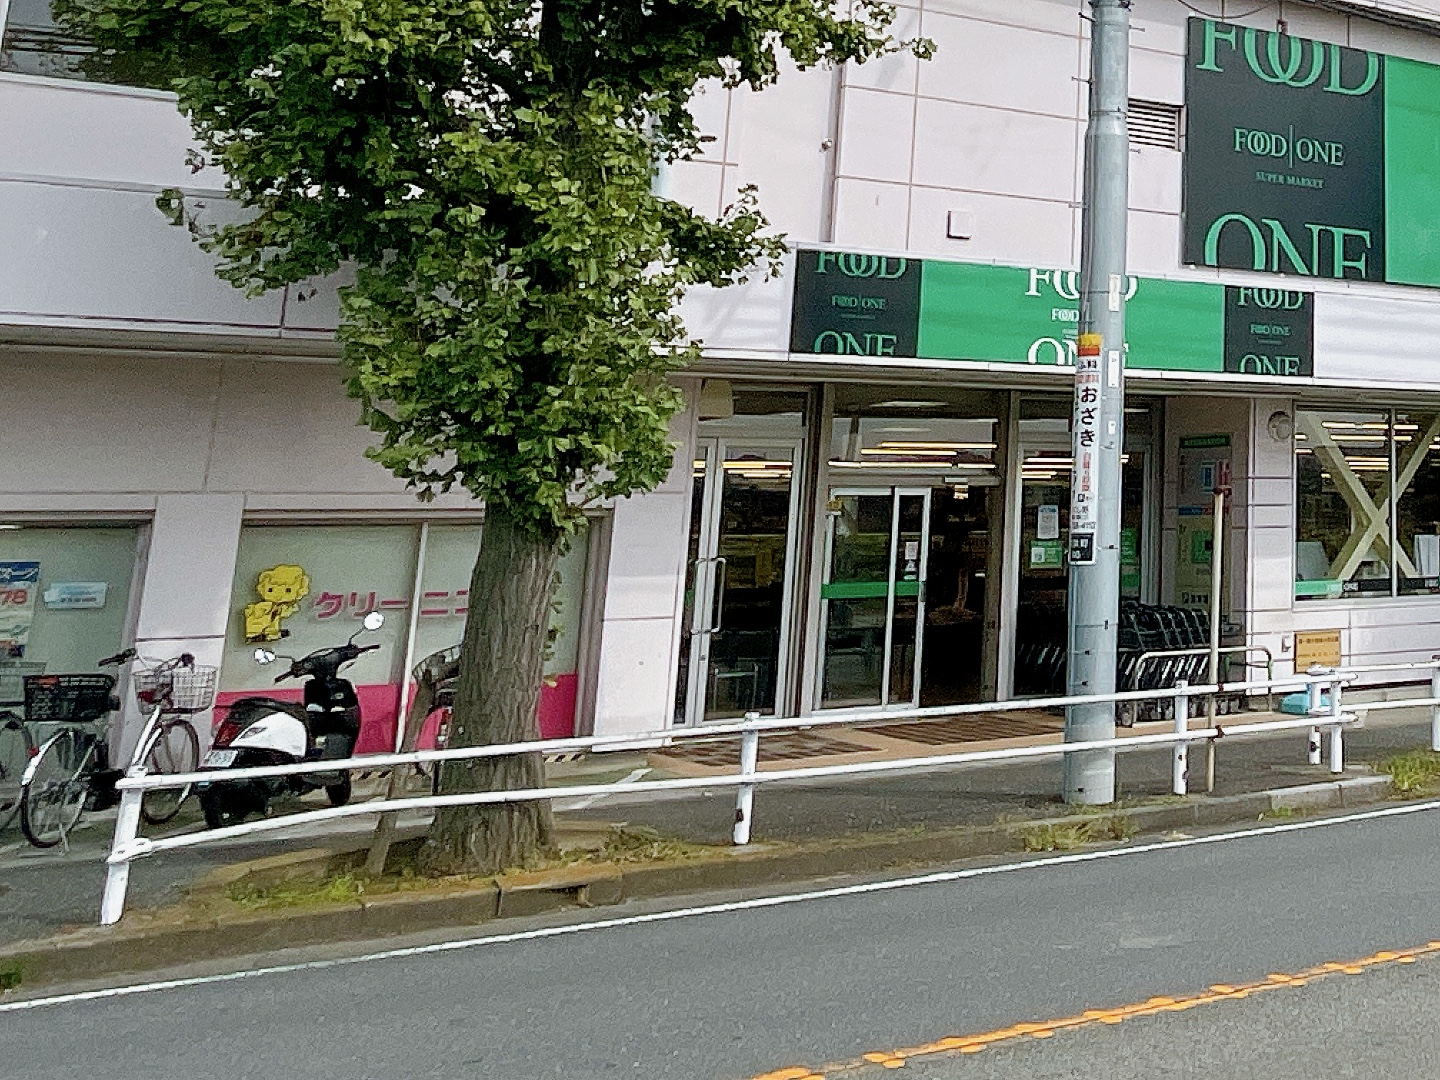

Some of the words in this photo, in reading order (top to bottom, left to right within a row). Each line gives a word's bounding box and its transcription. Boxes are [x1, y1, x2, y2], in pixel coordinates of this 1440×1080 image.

[1196, 19, 1380, 96] FOOD
[1234, 127, 1287, 157] FOOD
[1296, 138, 1345, 166] ONE
[815, 251, 907, 279] FOOD
[1204, 212, 1372, 279] ONE
[1238, 288, 1304, 309] FOOD
